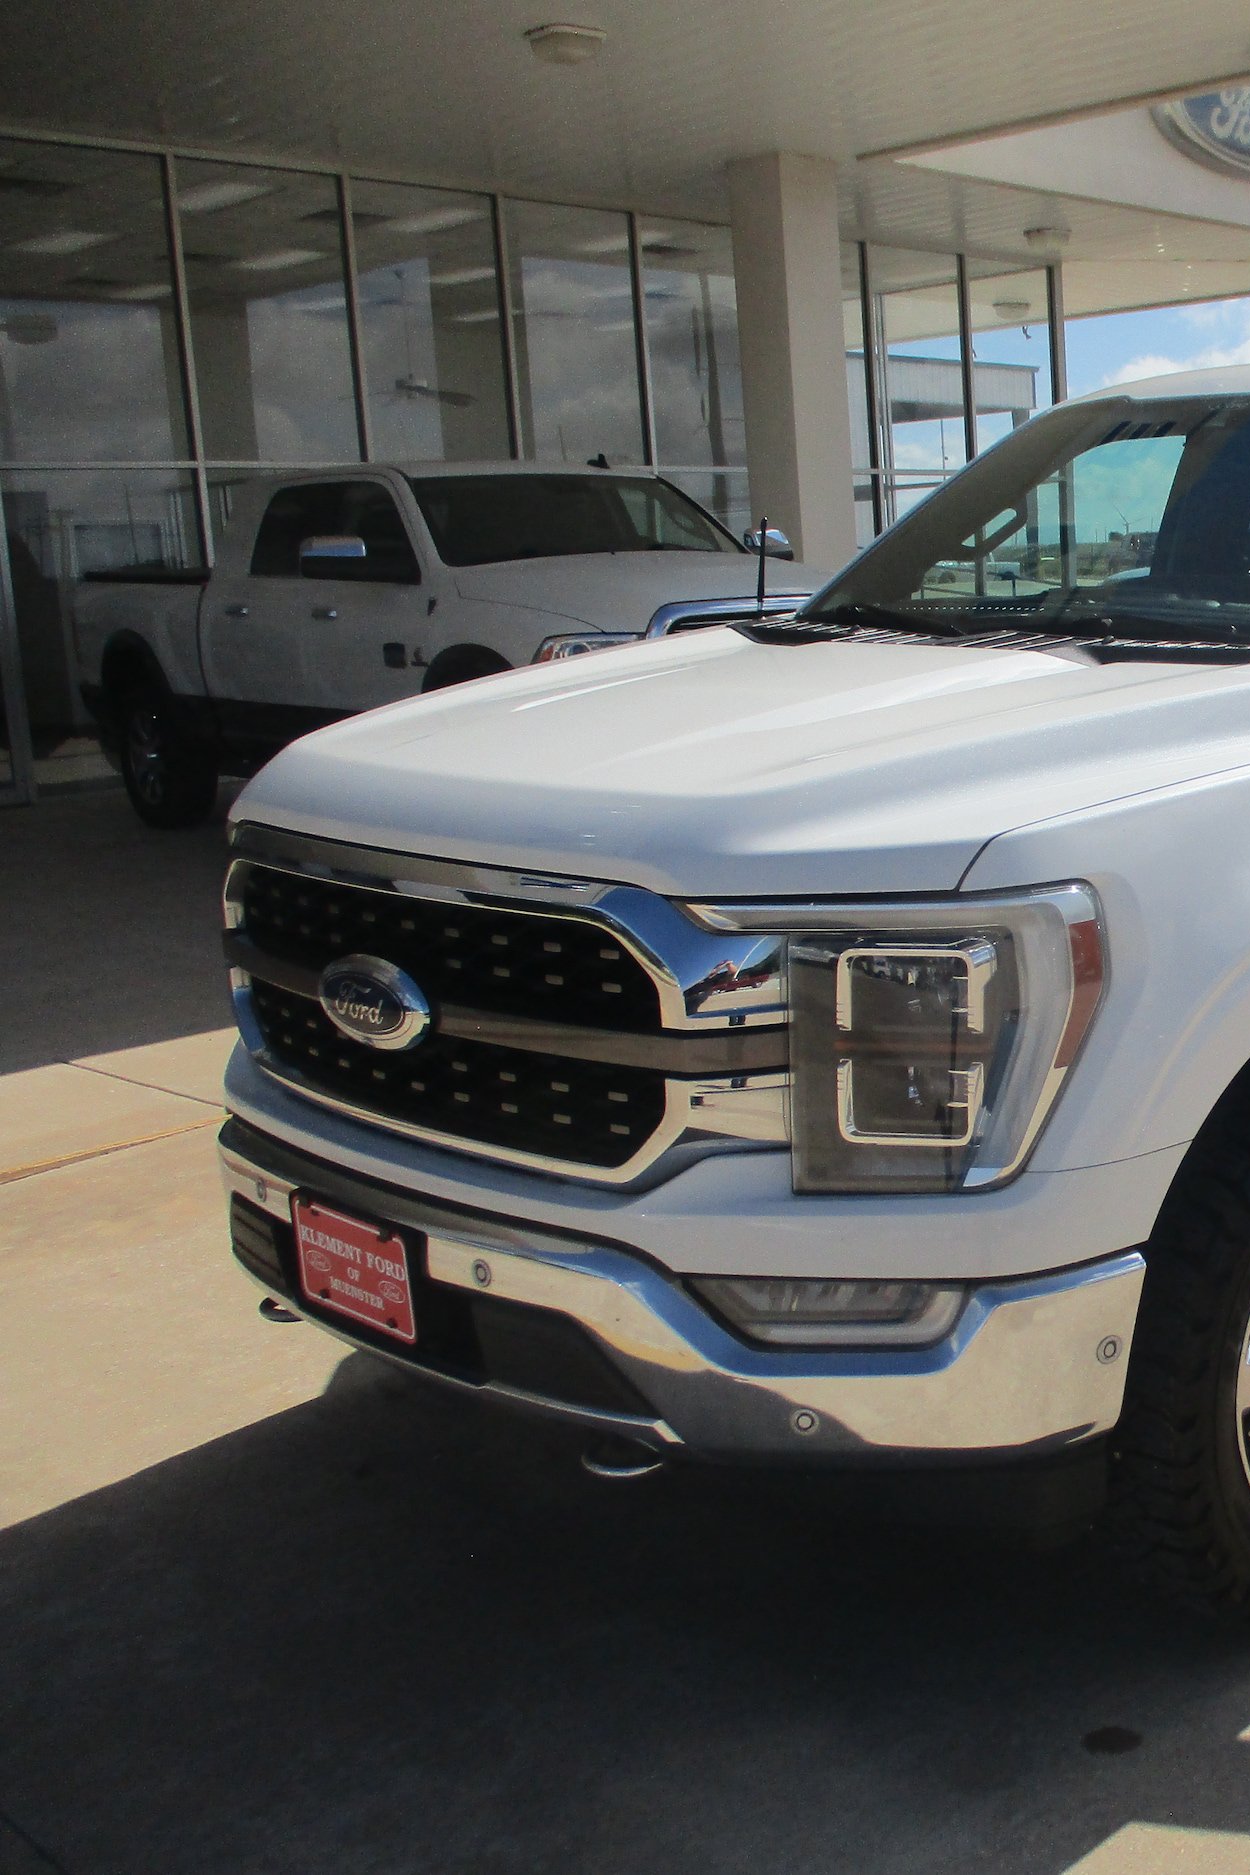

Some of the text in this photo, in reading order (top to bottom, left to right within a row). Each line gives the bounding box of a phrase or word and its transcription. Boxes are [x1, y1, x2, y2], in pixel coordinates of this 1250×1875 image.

[335, 980, 384, 1025] Ford
[300, 1225, 406, 1281] KLEMENT FORD
[330, 1276, 385, 1310] MUENSTER
[347, 1267, 360, 1282] OF
